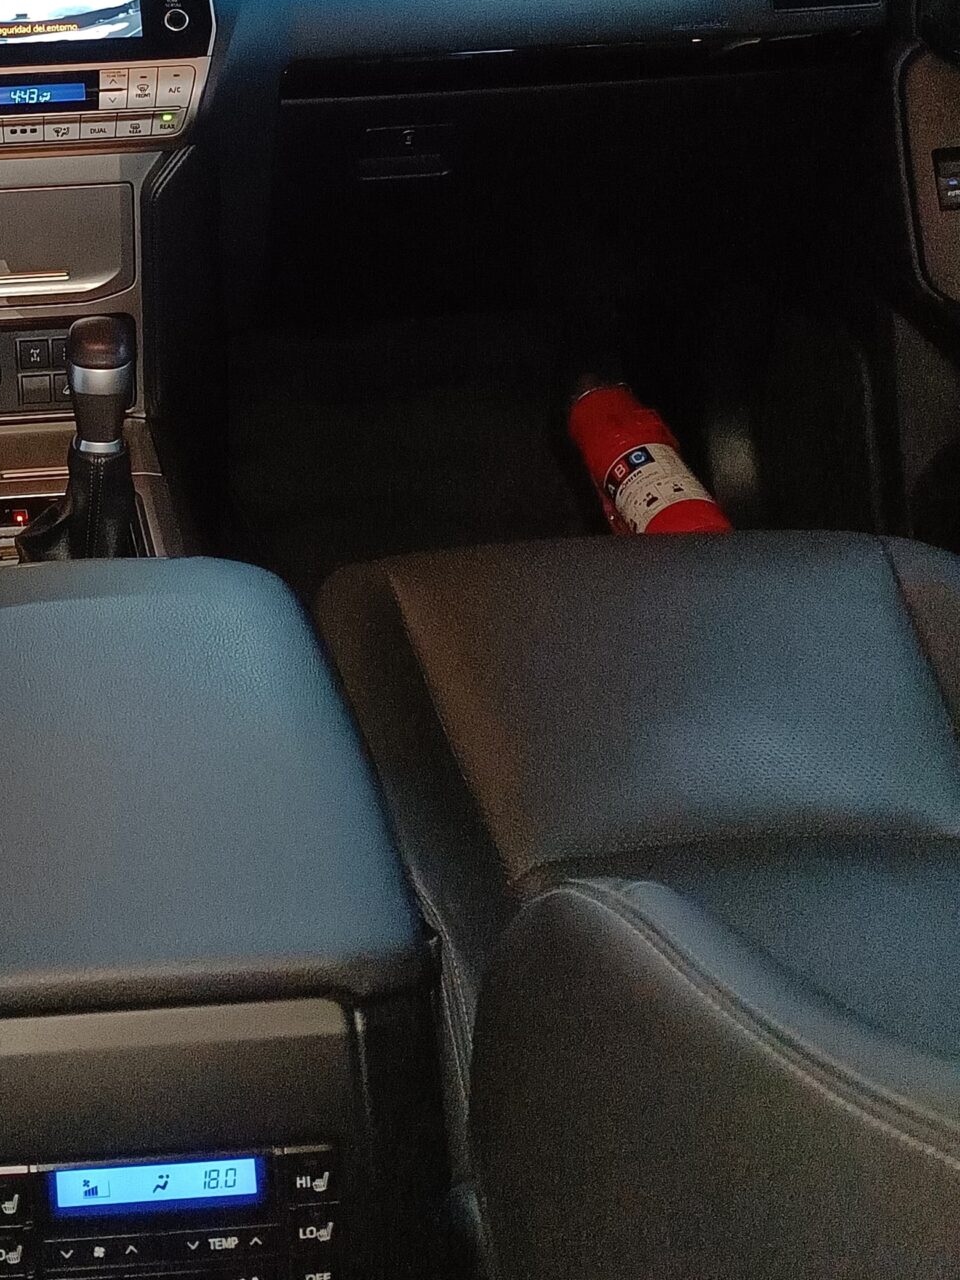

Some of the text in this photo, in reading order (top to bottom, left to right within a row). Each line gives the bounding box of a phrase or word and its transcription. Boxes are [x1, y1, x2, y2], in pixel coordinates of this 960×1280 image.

[168, 86, 182, 94] A/C
[90, 126, 107, 134] DUAL
[202, 1167, 237, 1191] 18.0
[296, 1176, 311, 1189] HI
[299, 1226, 316, 1239] LO
[208, 1236, 239, 1250] TEMP
